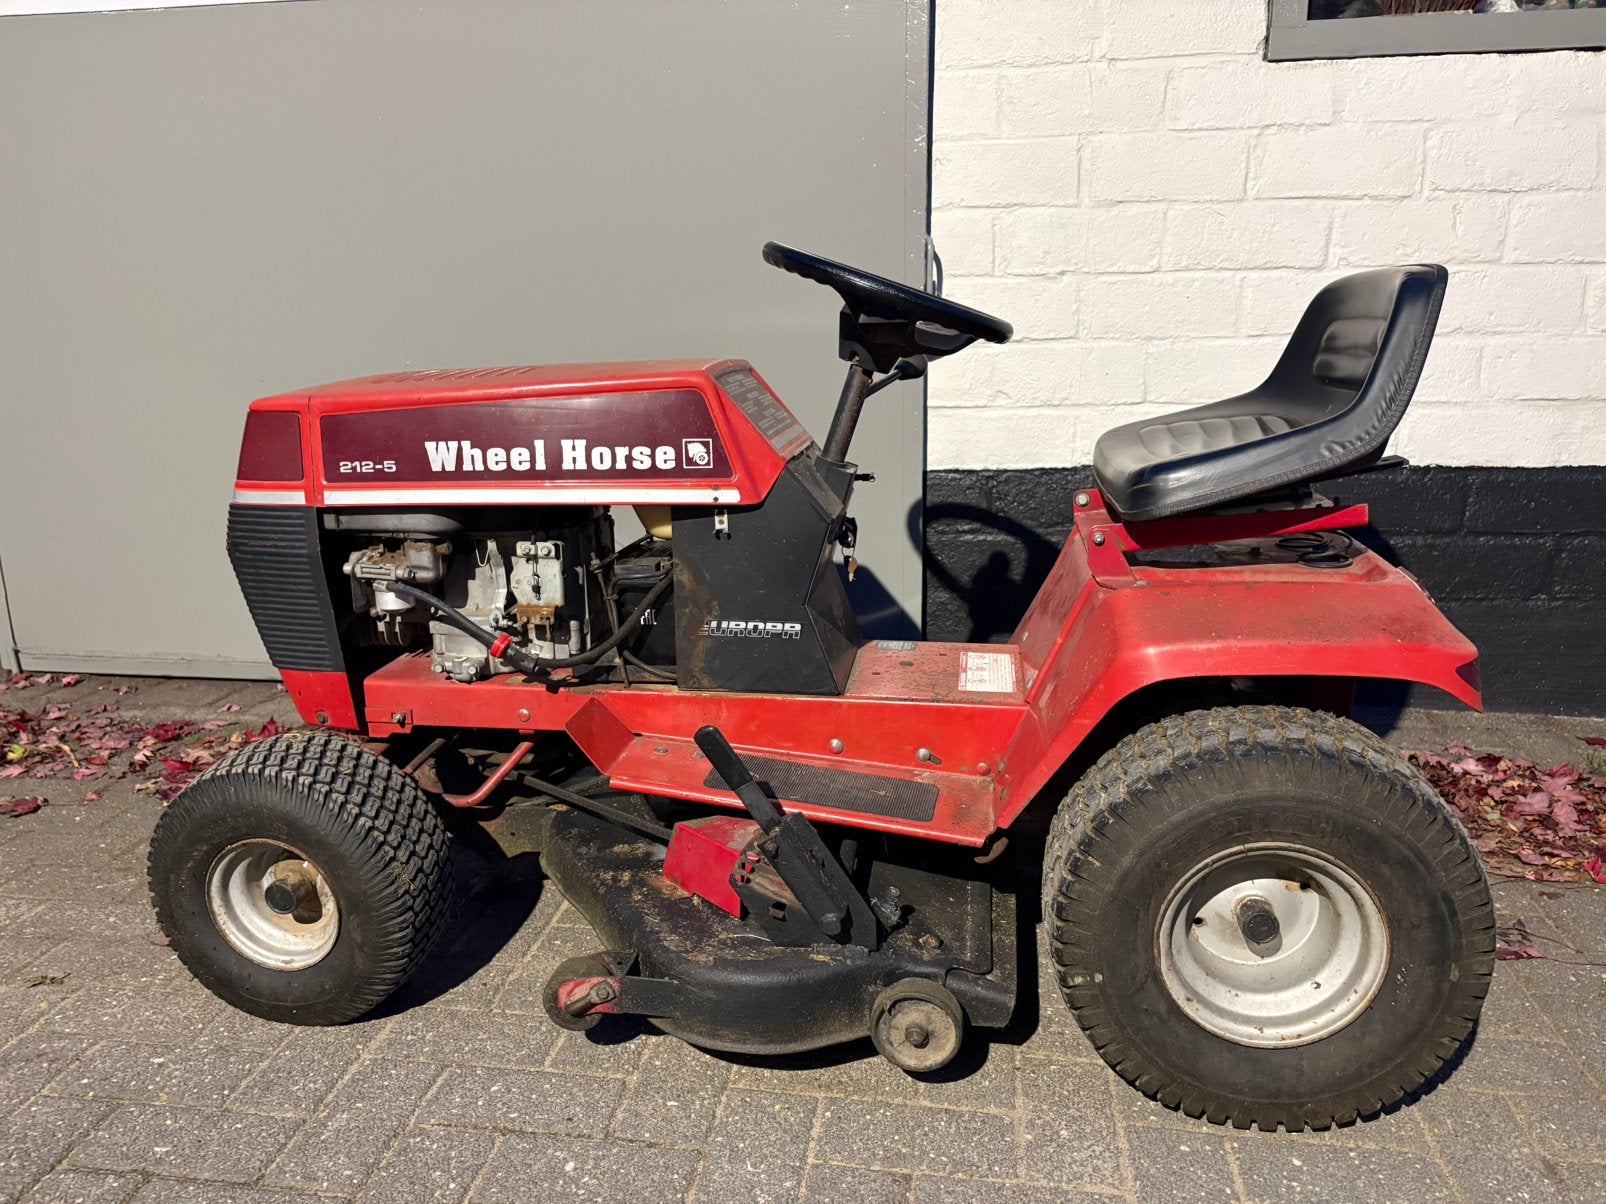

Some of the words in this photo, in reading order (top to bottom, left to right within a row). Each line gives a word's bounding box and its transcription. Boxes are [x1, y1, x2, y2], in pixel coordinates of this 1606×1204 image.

[339, 460, 397, 473] 212-5
[424, 439, 547, 472] Wheel
[561, 438, 676, 470] Horse
